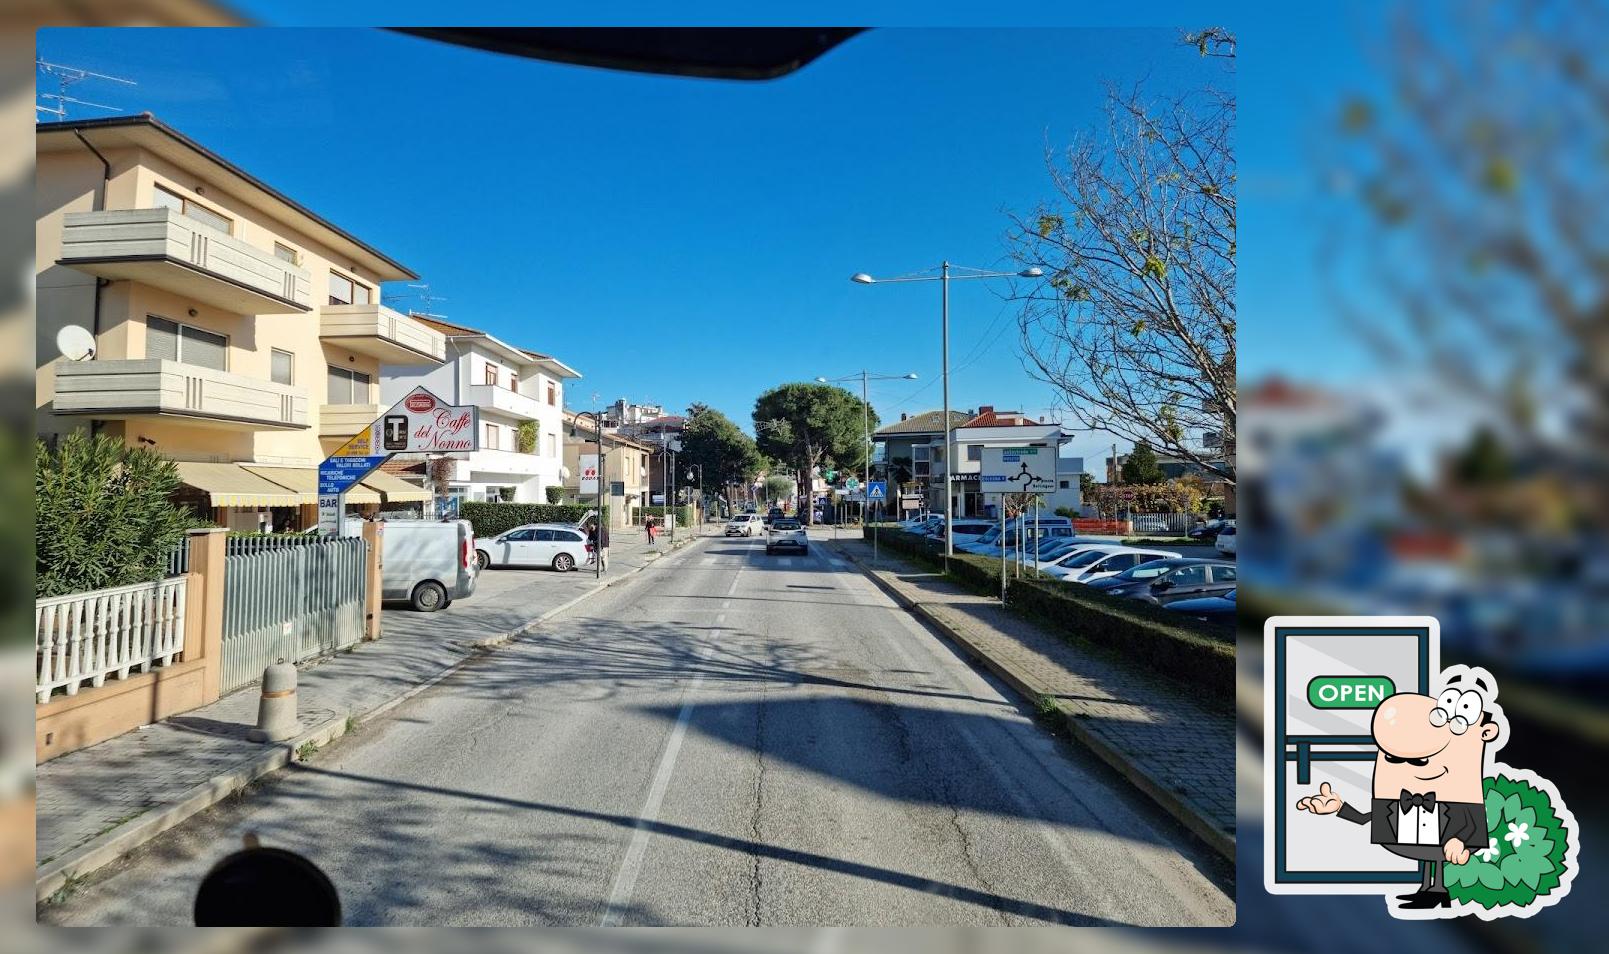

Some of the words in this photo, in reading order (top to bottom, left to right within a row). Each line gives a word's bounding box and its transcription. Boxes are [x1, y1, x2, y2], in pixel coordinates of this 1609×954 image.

[387, 418, 405, 441] T
[413, 425, 433, 439] del
[418, 430, 472, 451] Nonno
[949, 474, 979, 482] ARMAC
[319, 498, 337, 508] BAR
